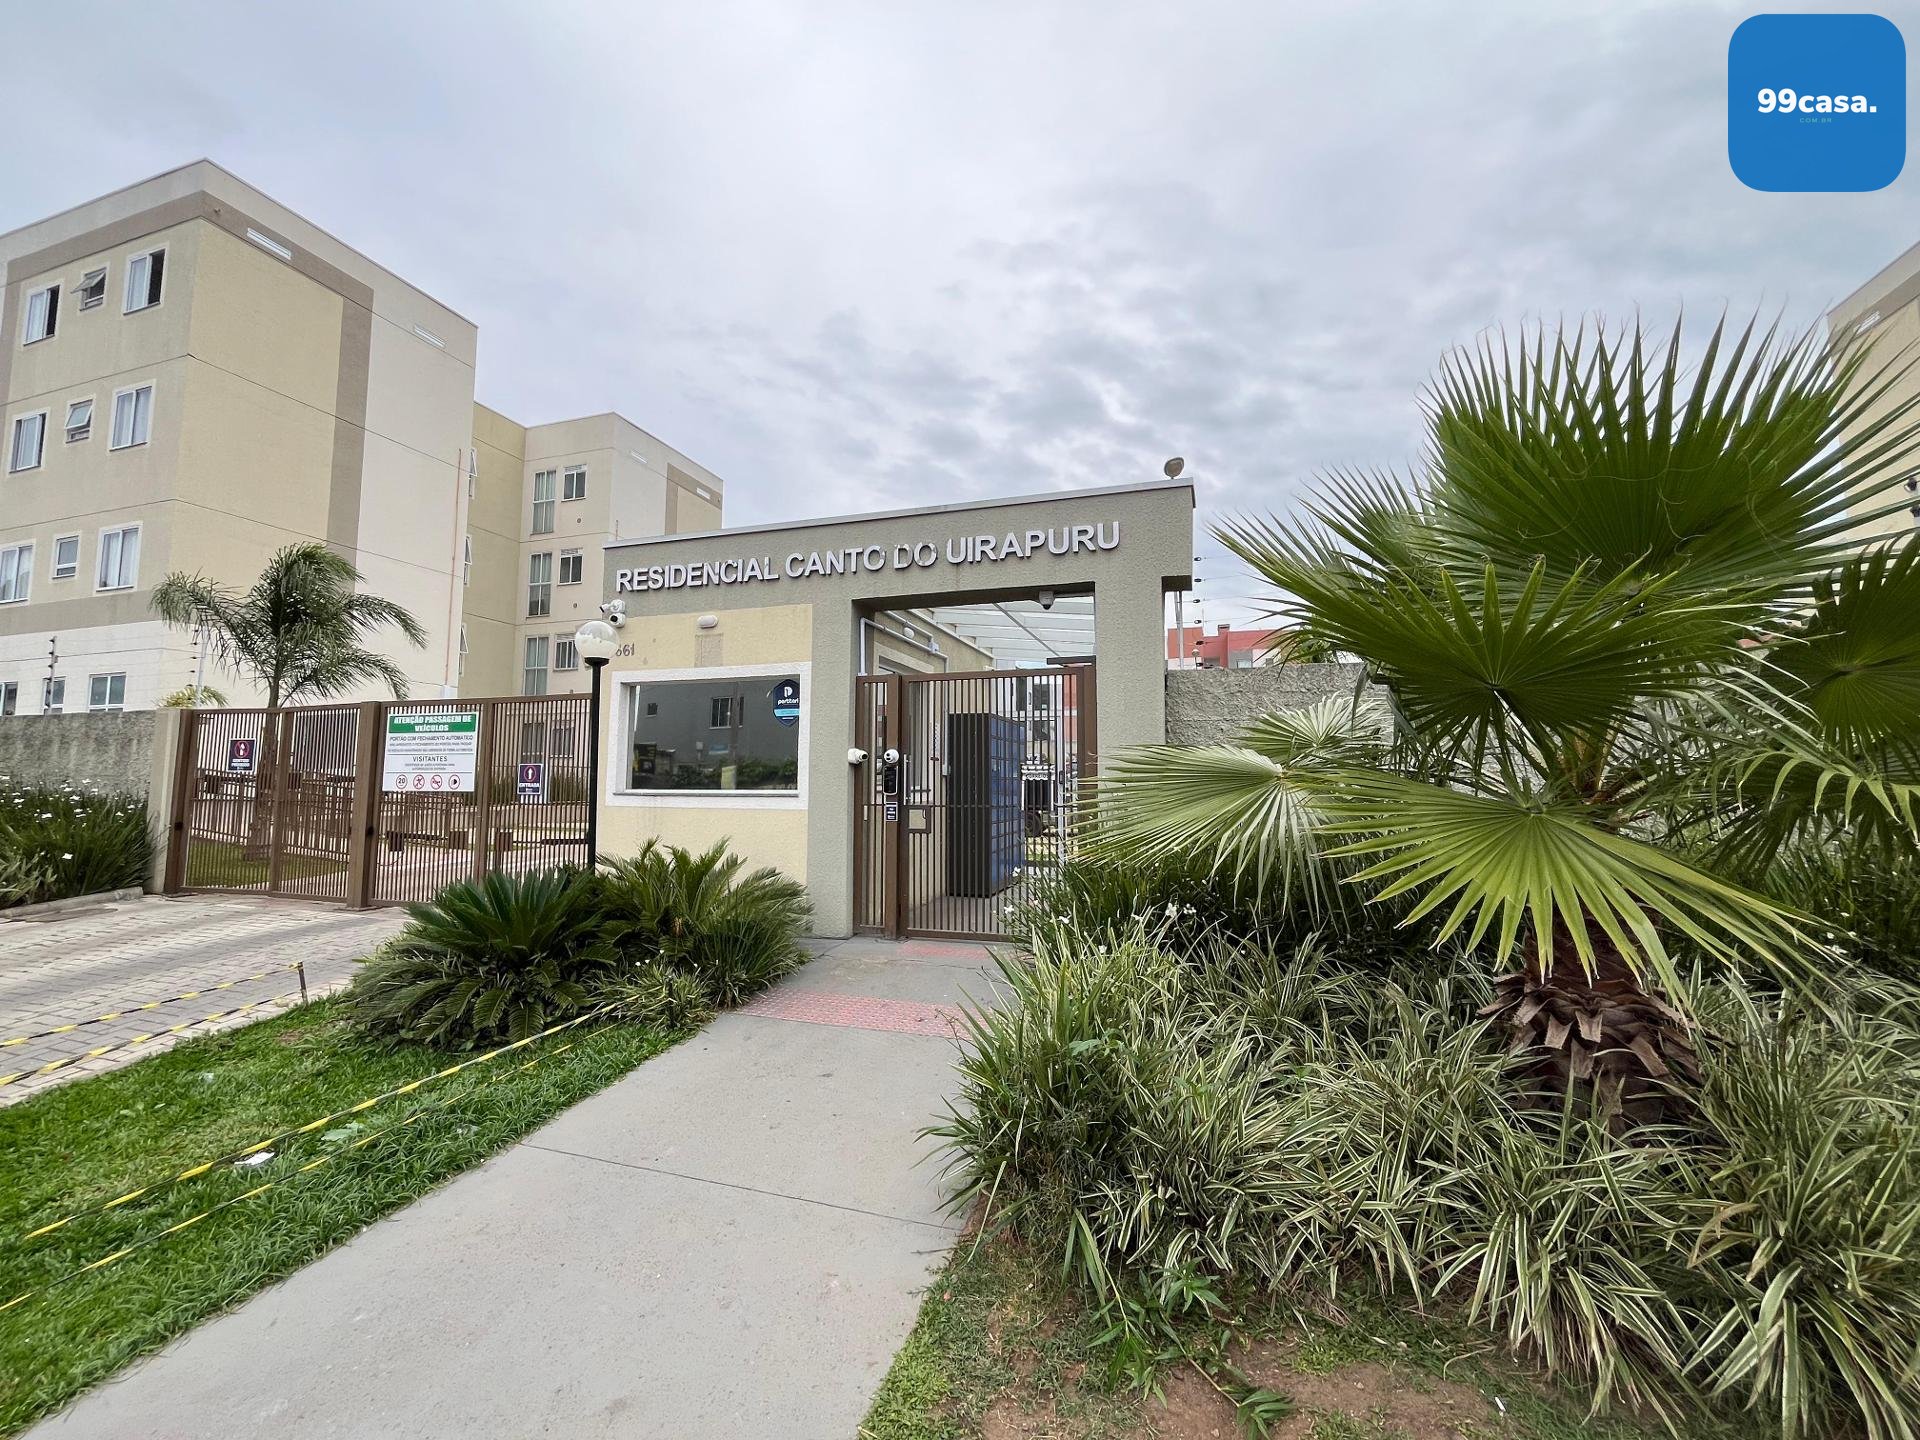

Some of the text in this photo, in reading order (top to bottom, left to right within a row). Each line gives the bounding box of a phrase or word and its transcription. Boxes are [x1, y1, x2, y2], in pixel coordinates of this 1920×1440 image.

[615, 521, 1121, 593] RESIDENCIAL CANTO DO UIRAPURU
[394, 714, 472, 724] ATENÇÃO PASSAGEM DE
